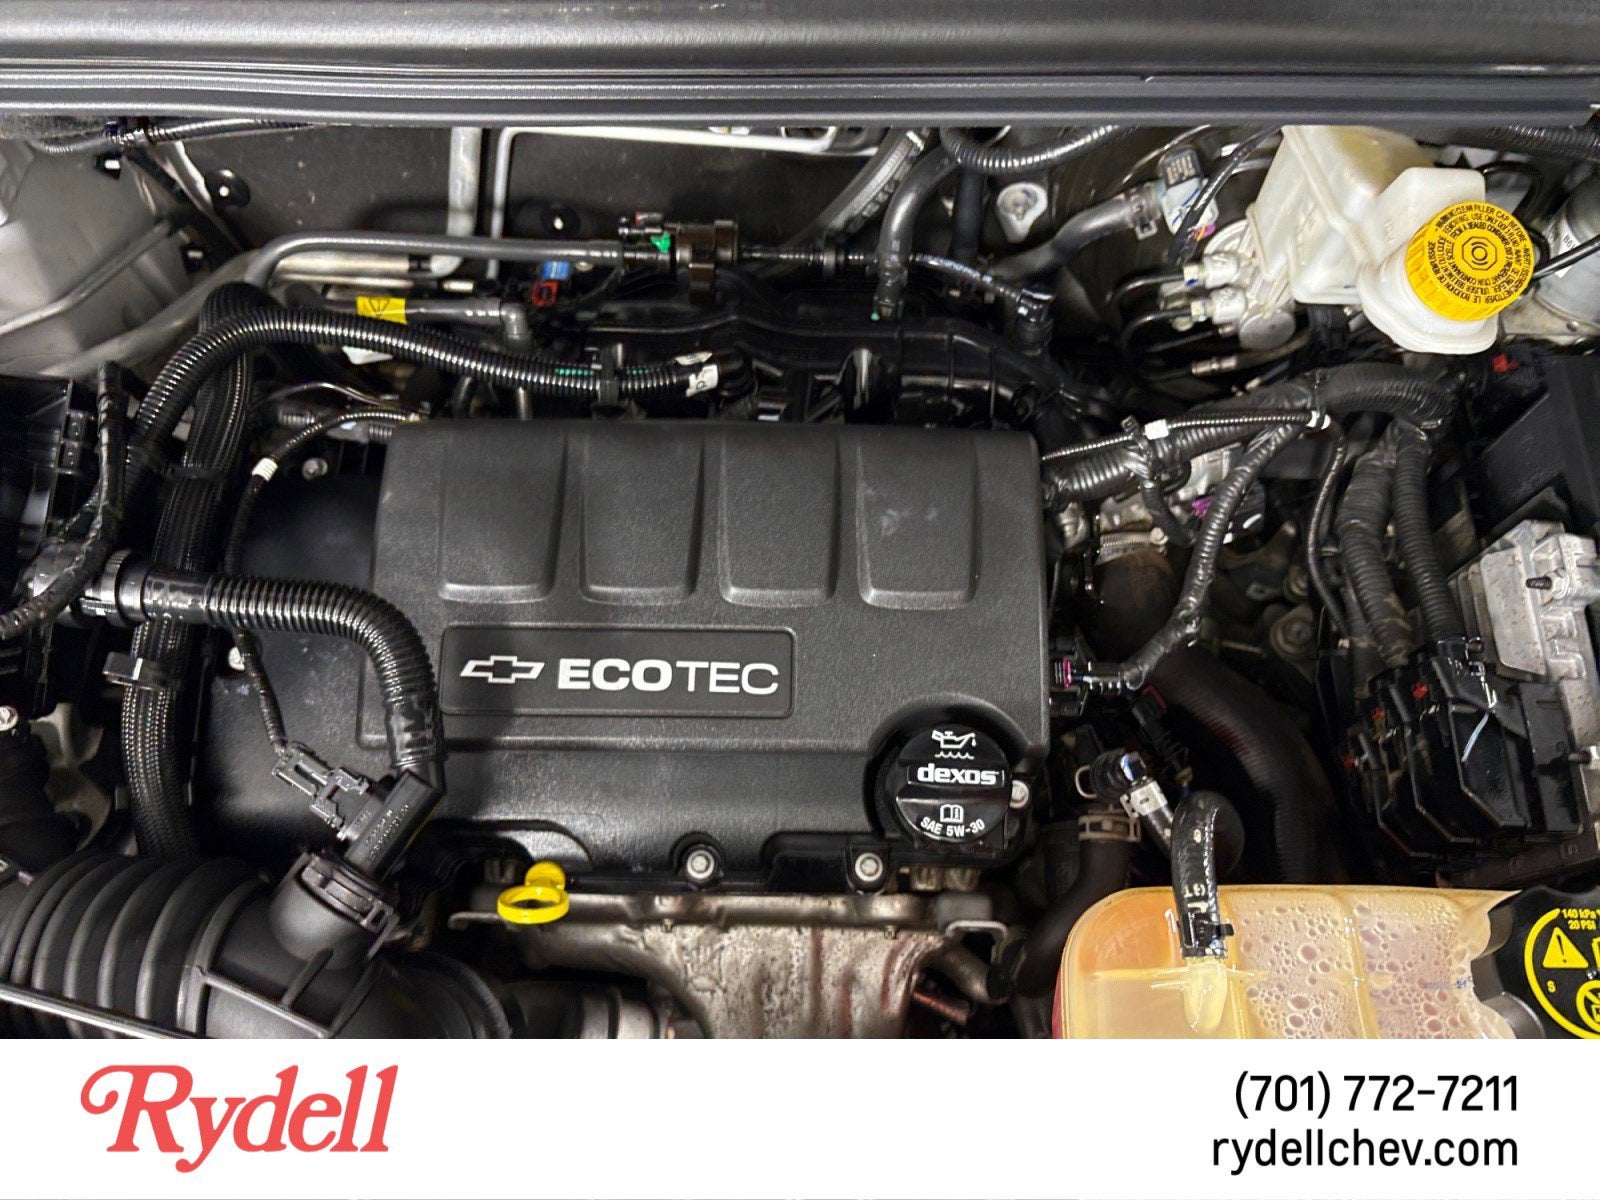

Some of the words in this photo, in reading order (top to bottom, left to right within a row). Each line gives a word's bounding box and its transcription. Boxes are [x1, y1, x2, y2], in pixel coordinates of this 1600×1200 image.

[1473, 203, 1494, 214] FILLER
[1496, 210, 1510, 221] CAP
[1507, 220, 1526, 242] BEFORE
[557, 657, 779, 696] ECOTEC
[917, 763, 999, 785] dexos
[920, 817, 942, 834] SAE
[946, 819, 985, 837] 5W-30
[1561, 908, 1579, 919] 140
[1579, 908, 1597, 919] kPa
[1567, 919, 1580, 930] 20
[1580, 919, 1597, 930] PSI
